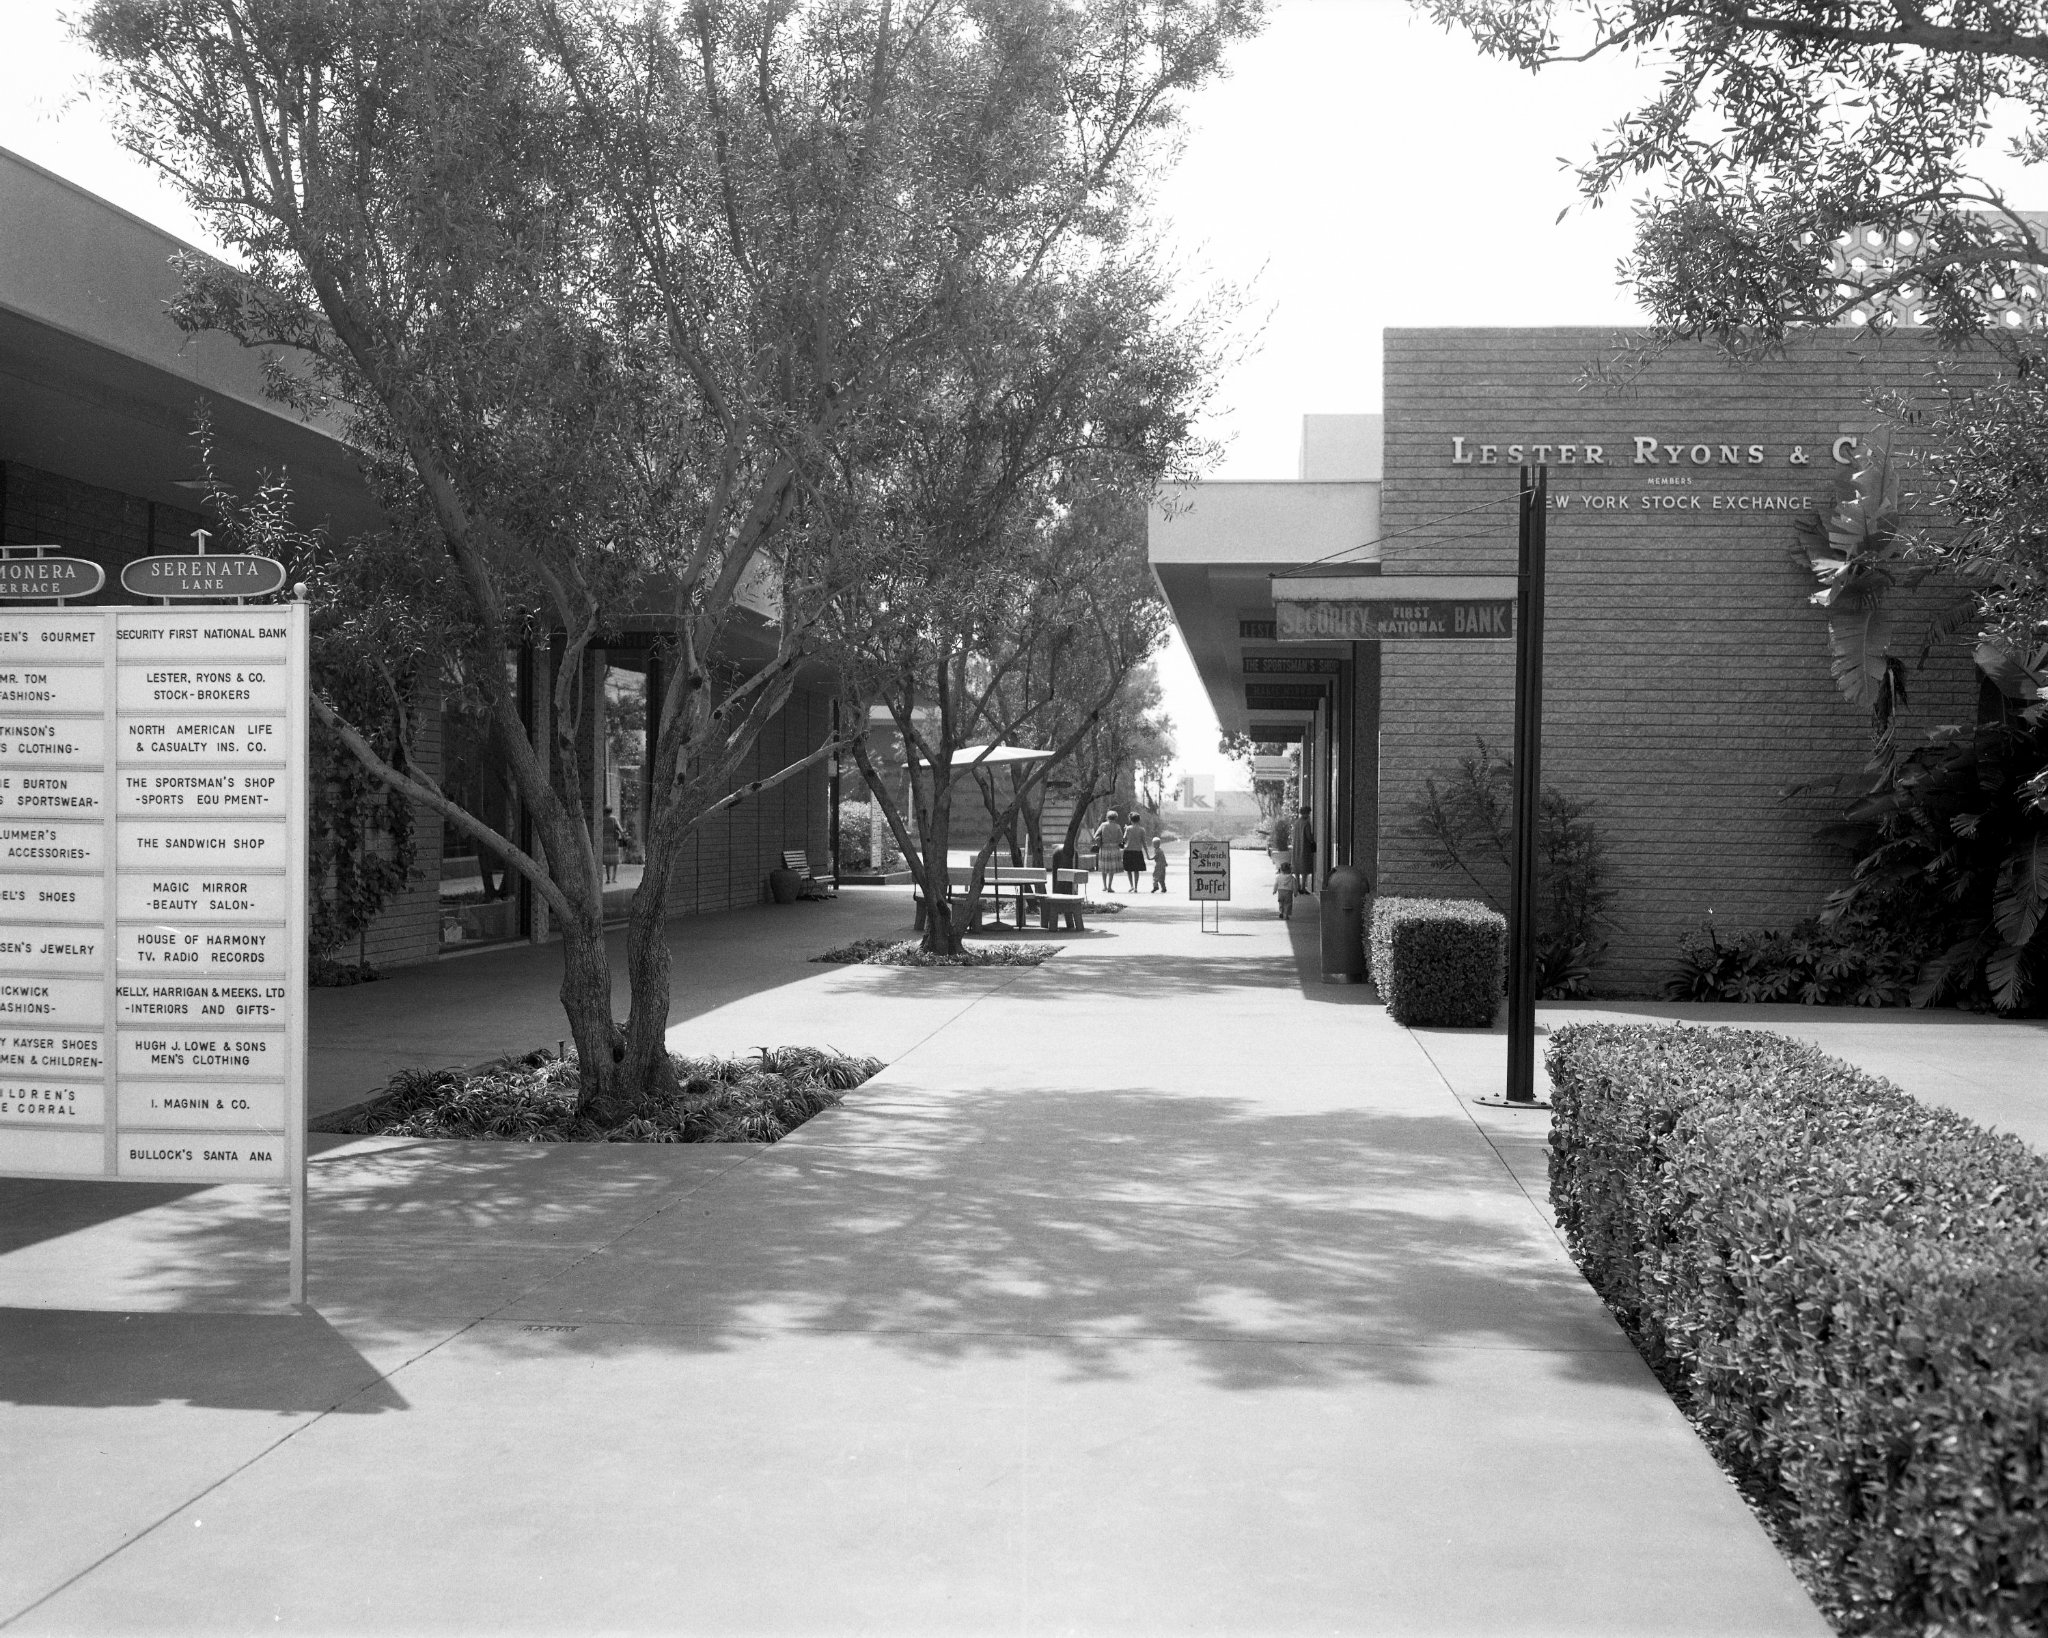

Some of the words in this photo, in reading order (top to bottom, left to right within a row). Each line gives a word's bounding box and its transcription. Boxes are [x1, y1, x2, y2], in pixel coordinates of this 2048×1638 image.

[1634, 437, 1763, 463] RYONS
[1790, 446, 1808, 463] &
[1833, 437, 1859, 463] C
[1647, 477, 1692, 485] MEMBERS
[1546, 496, 1569, 508] EW
[1582, 496, 1628, 508] YORK
[1642, 496, 1700, 508] STOCK
[1713, 496, 1812, 510] EXCHANGE
[152, 562, 258, 576] SERENATA
[183, 580, 223, 589] LANE
[1283, 605, 1369, 633] SECURITY
[1393, 606, 1430, 618] FIRST
[1455, 606, 1506, 632] BANK
[1378, 621, 1445, 633] NATIONAL
[41, 632, 95, 642] GOURMET
[117, 630, 164, 639] SECURITY
[170, 629, 198, 638] FIRST
[204, 629, 254, 638] NATIONAL
[259, 629, 286, 638] BANK
[1245, 659, 1259, 671] THE
[25, 674, 46, 683] TOM
[147, 673, 190, 683] LESTER,
[197, 673, 231, 682] RYONS
[237, 673, 244, 682] &
[249, 673, 265, 682] CO.
[130, 725, 164, 734] NORTH
[177, 725, 234, 734] AMERICAN
[248, 725, 272, 734] LIFE
[19, 744, 78, 753] CLOTHING-
[137, 743, 144, 751] &
[152, 742, 207, 752] CASUALTY
[218, 743, 238, 751] INS.
[248, 742, 266, 751] CO.
[24, 779, 66, 789] BURTON
[127, 778, 147, 787] THE
[156, 777, 234, 787] SPORTSMAN'S
[245, 778, 274, 787] SHOP
[18, 796, 98, 806] SPORTSWEAR-
[136, 795, 183, 804] -SPORTS
[137, 838, 158, 847] THE
[166, 839, 225, 848] SANDWICH
[234, 839, 264, 848] SHOP
[9, 848, 90, 858] ACCESSORIES-
[1192, 849, 1226, 859] Sandwich
[1198, 859, 1221, 868] Shop
[154, 883, 189, 892] MAGIC
[203, 883, 247, 892] MIRROR
[1195, 878, 1226, 893] Buffet
[2, 891, 24, 900] EL'S
[40, 892, 75, 902] SHOES
[147, 900, 197, 909] -BEAUTY
[210, 900, 254, 909] SALON-
[138, 935, 175, 944] HOUSE
[185, 935, 198, 944] OF
[207, 936, 265, 945] HARMONY
[41, 945, 94, 954] JEWELRY
[165, 952, 198, 961] RADIO
[212, 953, 264, 962] RECORDS
[154, 988, 208, 997] HARRIGAN
[212, 988, 219, 997] &
[266, 988, 285, 997] LTD
[126, 1004, 188, 1013] -INTERIORS
[202, 1005, 224, 1014] AND
[237, 1005, 275, 1014] GIFTS-
[14, 1039, 53, 1048] KAYSER
[62, 1040, 97, 1050] SHOES
[136, 1041, 166, 1050] HUGH
[171, 1041, 181, 1050] J.
[185, 1042, 215, 1051] LOWE
[224, 1042, 231, 1051] &
[236, 1042, 265, 1051] SONS
[31, 1056, 37, 1064] &
[42, 1056, 103, 1066] CHILDREN-
[152, 1054, 183, 1064] MEN'S
[193, 1056, 249, 1065] CLOTHING
[165, 1099, 208, 1108] MAGNIN
[217, 1100, 224, 1109] &
[232, 1100, 249, 1109] CO.
[18, 1104, 75, 1115] CORRAL
[130, 1150, 192, 1160] BULLOCK'S
[204, 1151, 238, 1160] SANTA
[250, 1152, 272, 1161] ANA
